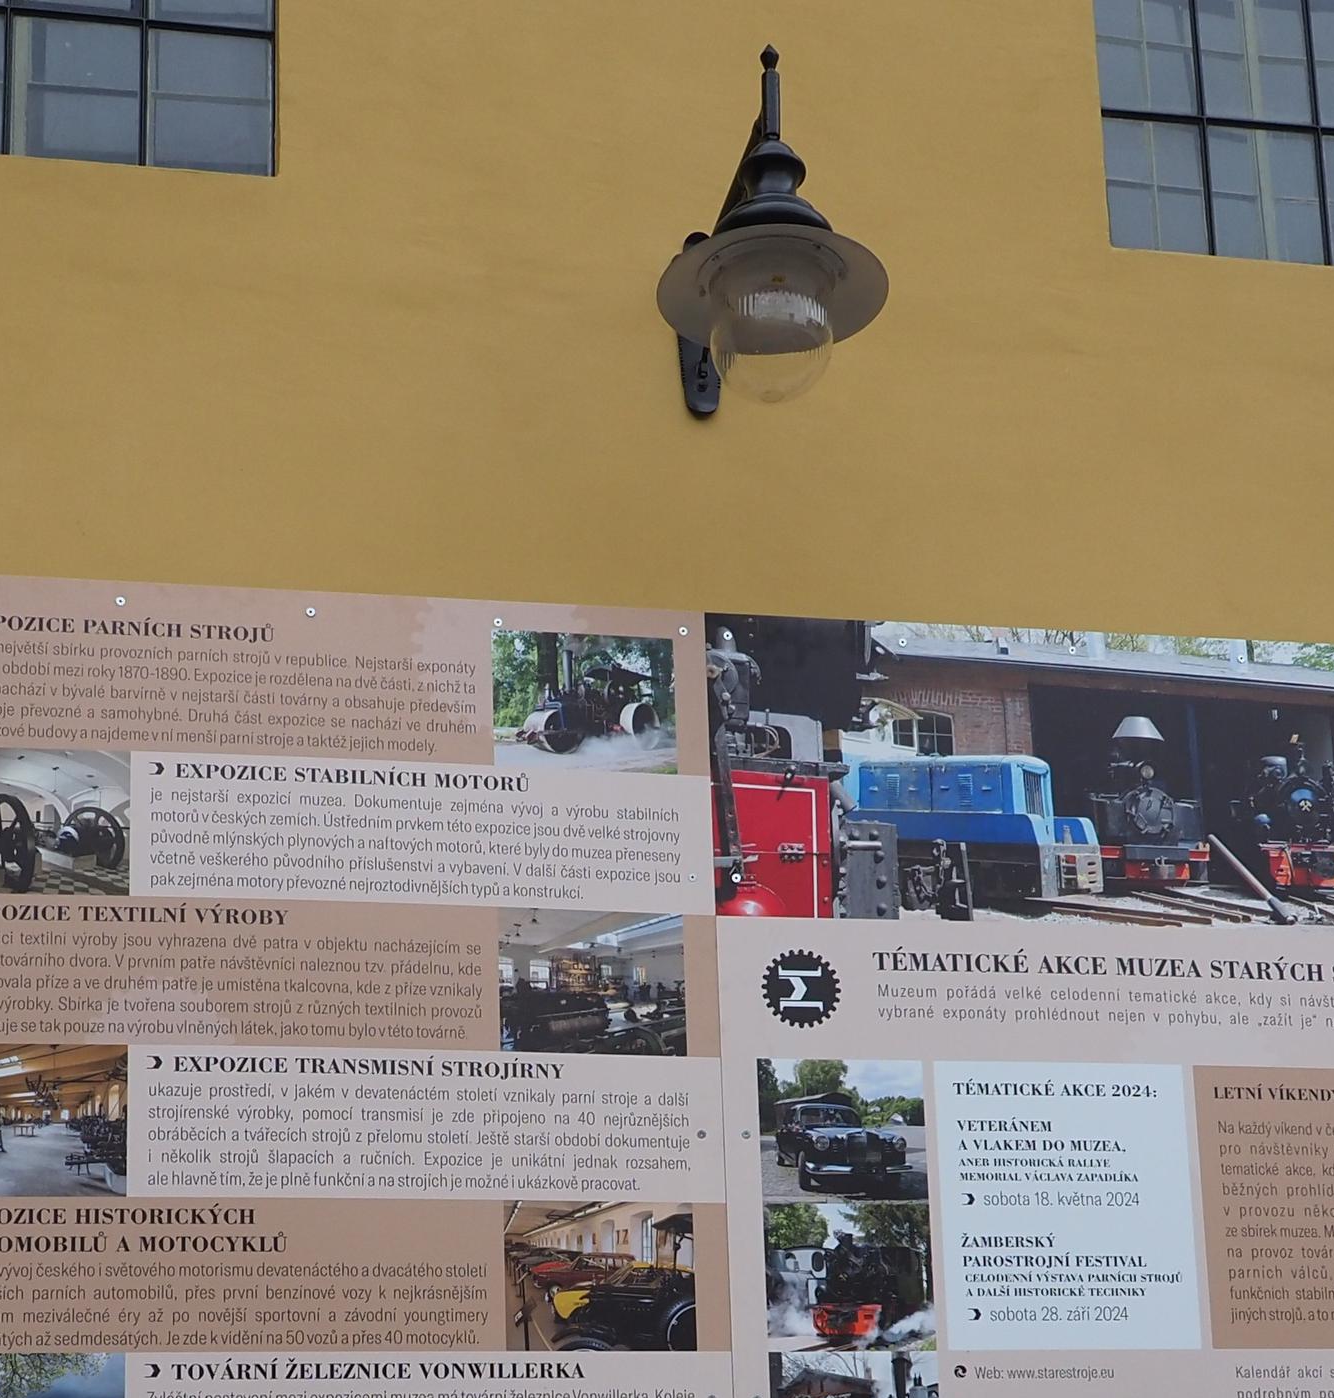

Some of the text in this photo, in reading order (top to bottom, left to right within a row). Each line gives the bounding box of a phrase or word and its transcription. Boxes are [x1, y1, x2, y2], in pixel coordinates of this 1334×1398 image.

[84, 617, 181, 637] PARNÍCH
[190, 623, 273, 643] STROJŮ
[176, 763, 528, 792] EXPOZICE STABILNÍCH MOTORŮ
[78, 902, 186, 922] TEXTILNÍ
[195, 903, 287, 924] VÝROBY
[872, 946, 1028, 973] TÉMATICKÉ
[1038, 955, 1106, 975] AKCE
[1116, 957, 1201, 977] MUZEA
[1210, 956, 1323, 981] STARÝCH
[174, 1055, 563, 1080] EXPOZICE TRANSMISNÍ STROJÍRNY
[953, 1078, 1156, 1097] TÉMATICKÉ AKCE 2024:
[1214, 1083, 1261, 1099] LETNÍ
[983, 1191, 1139, 1206] sobota 18. května 2024
[75, 1203, 254, 1224] HISTORICKÝCH
[116, 1236, 129, 1252] A
[139, 1231, 286, 1252] MOTOCYKLŮ
[961, 1232, 1054, 1247] ŽAMBERSKÝ
[963, 1252, 1146, 1268] PAROSTROJNÍ FESTIVAL
[171, 1358, 584, 1380] TOVÁRNÍ ŽELEZNICE VONWILLERKA
